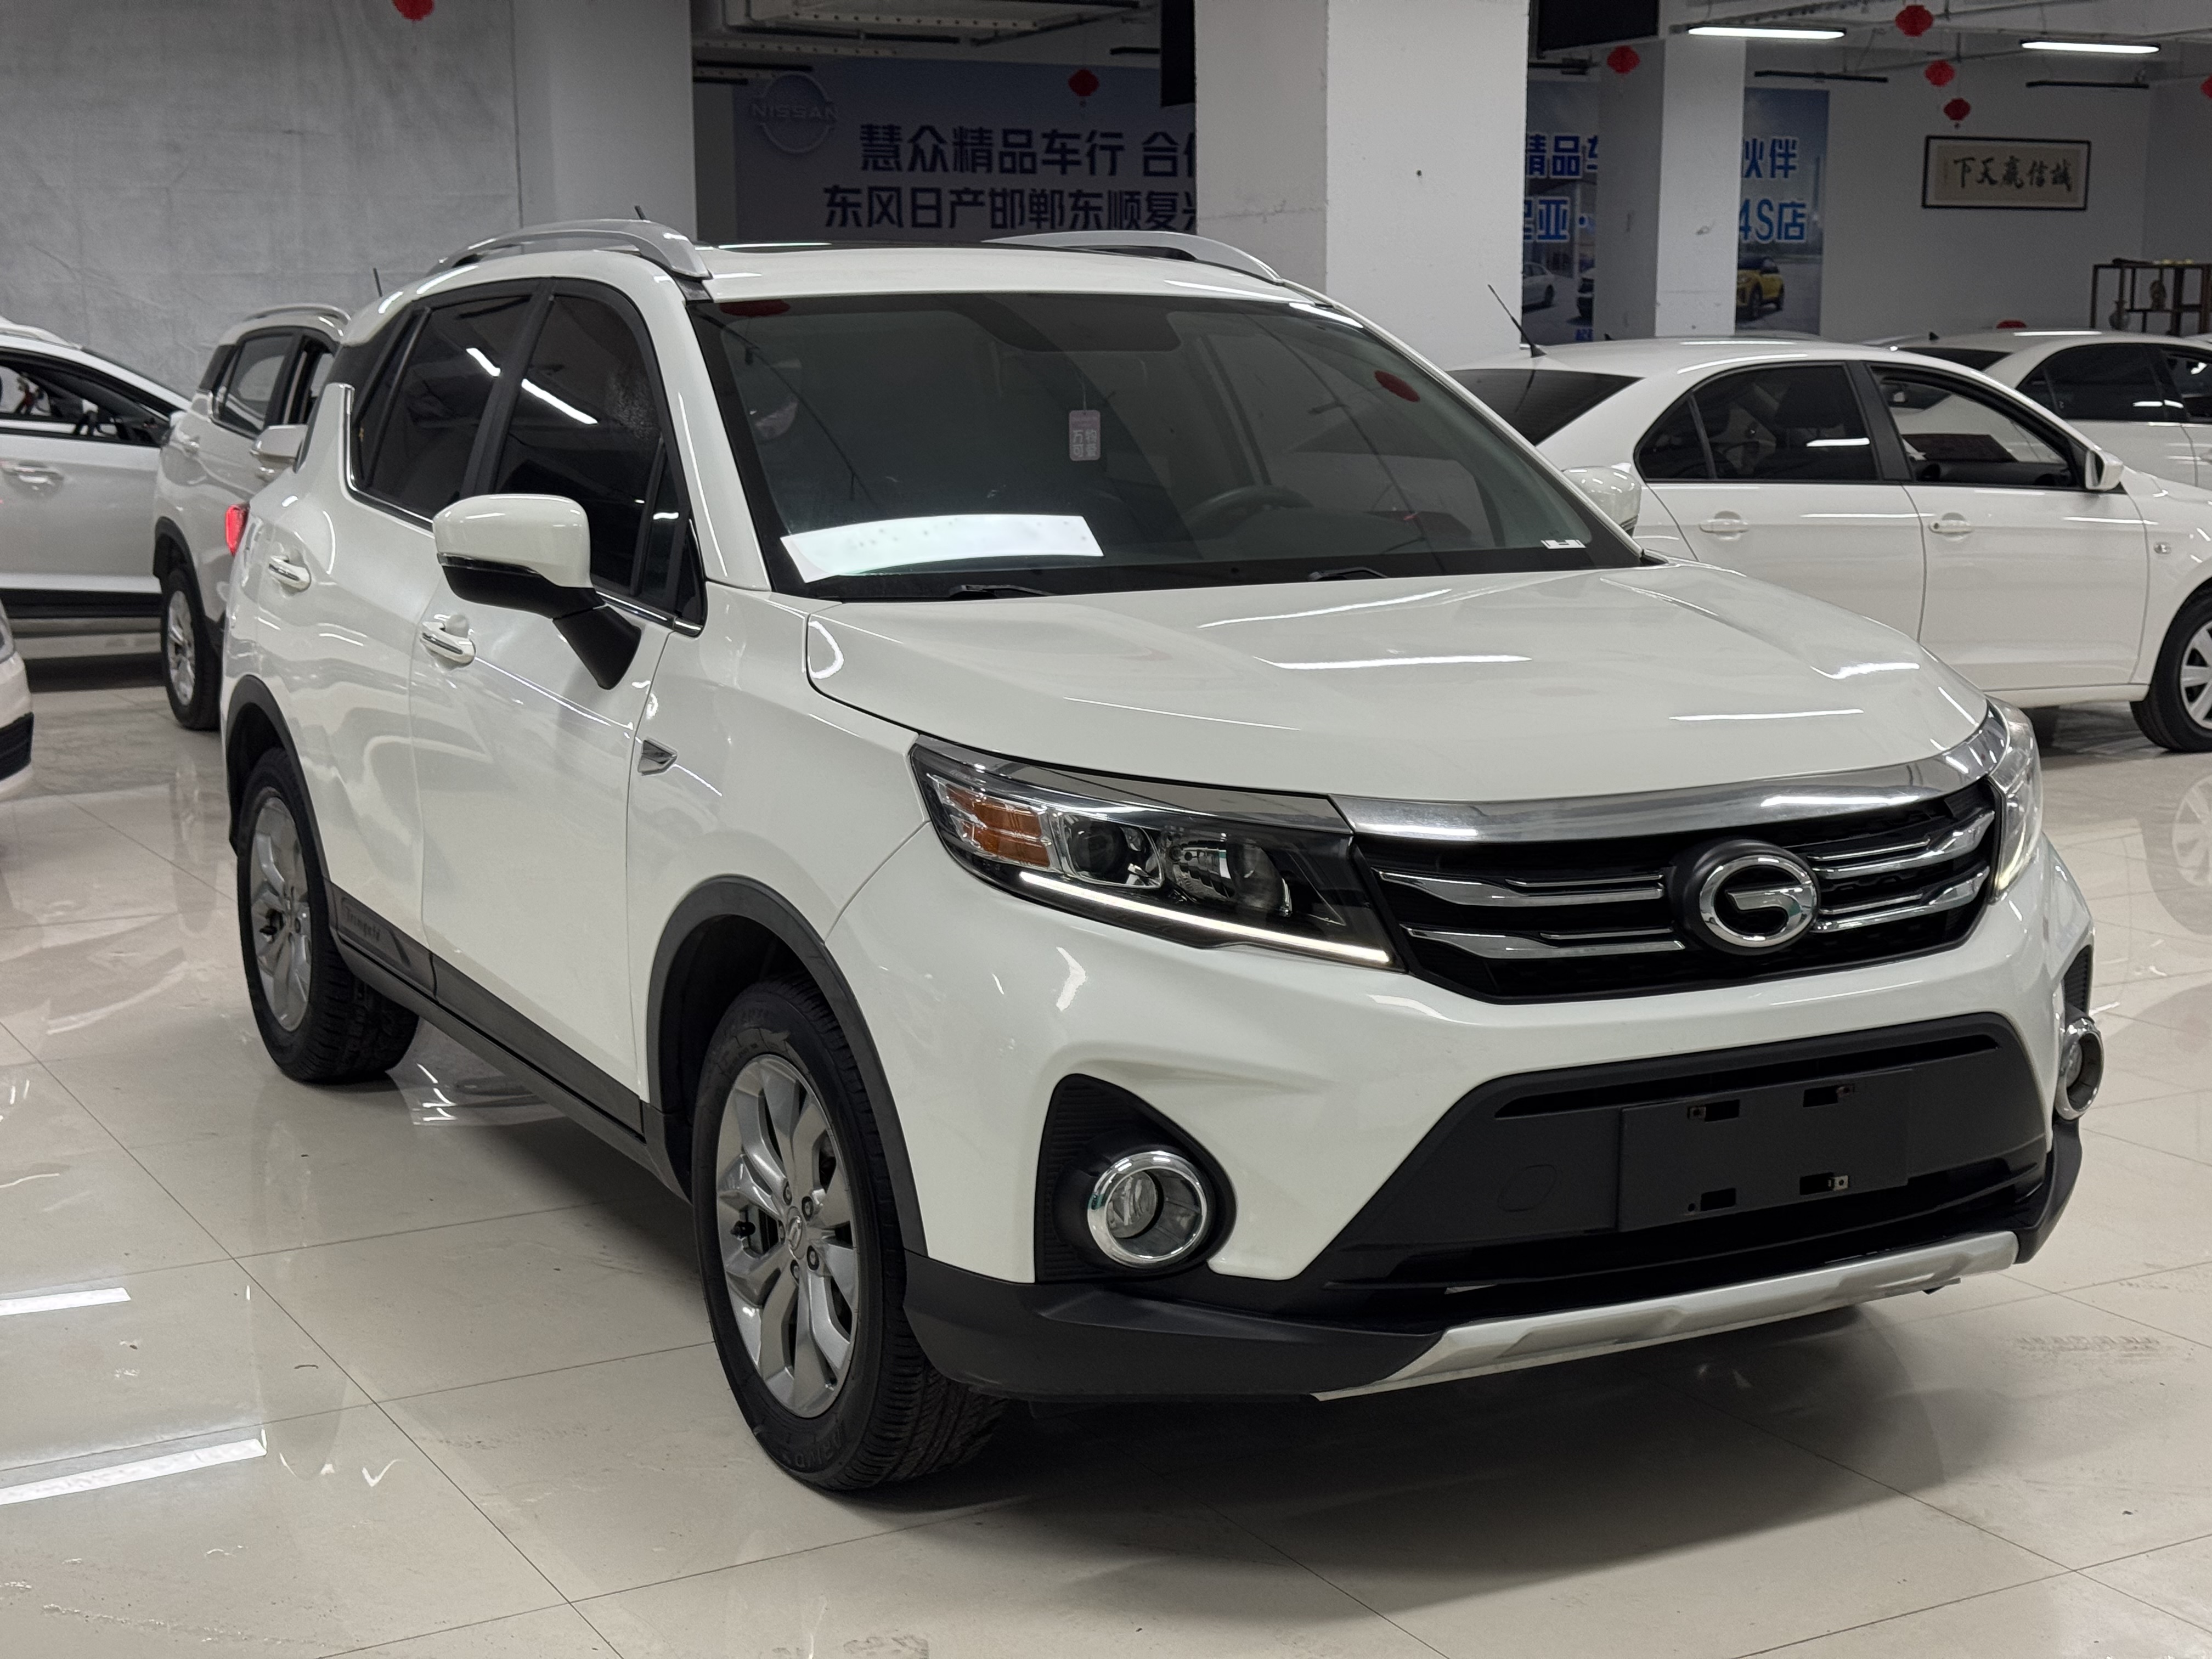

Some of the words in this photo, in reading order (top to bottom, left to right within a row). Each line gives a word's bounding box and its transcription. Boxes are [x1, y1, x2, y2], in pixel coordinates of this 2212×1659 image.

[749, 103, 838, 119] NISSAN
[860, 123, 1125, 176] 慧众精品车行
[1739, 198, 1807, 241] 4S店
